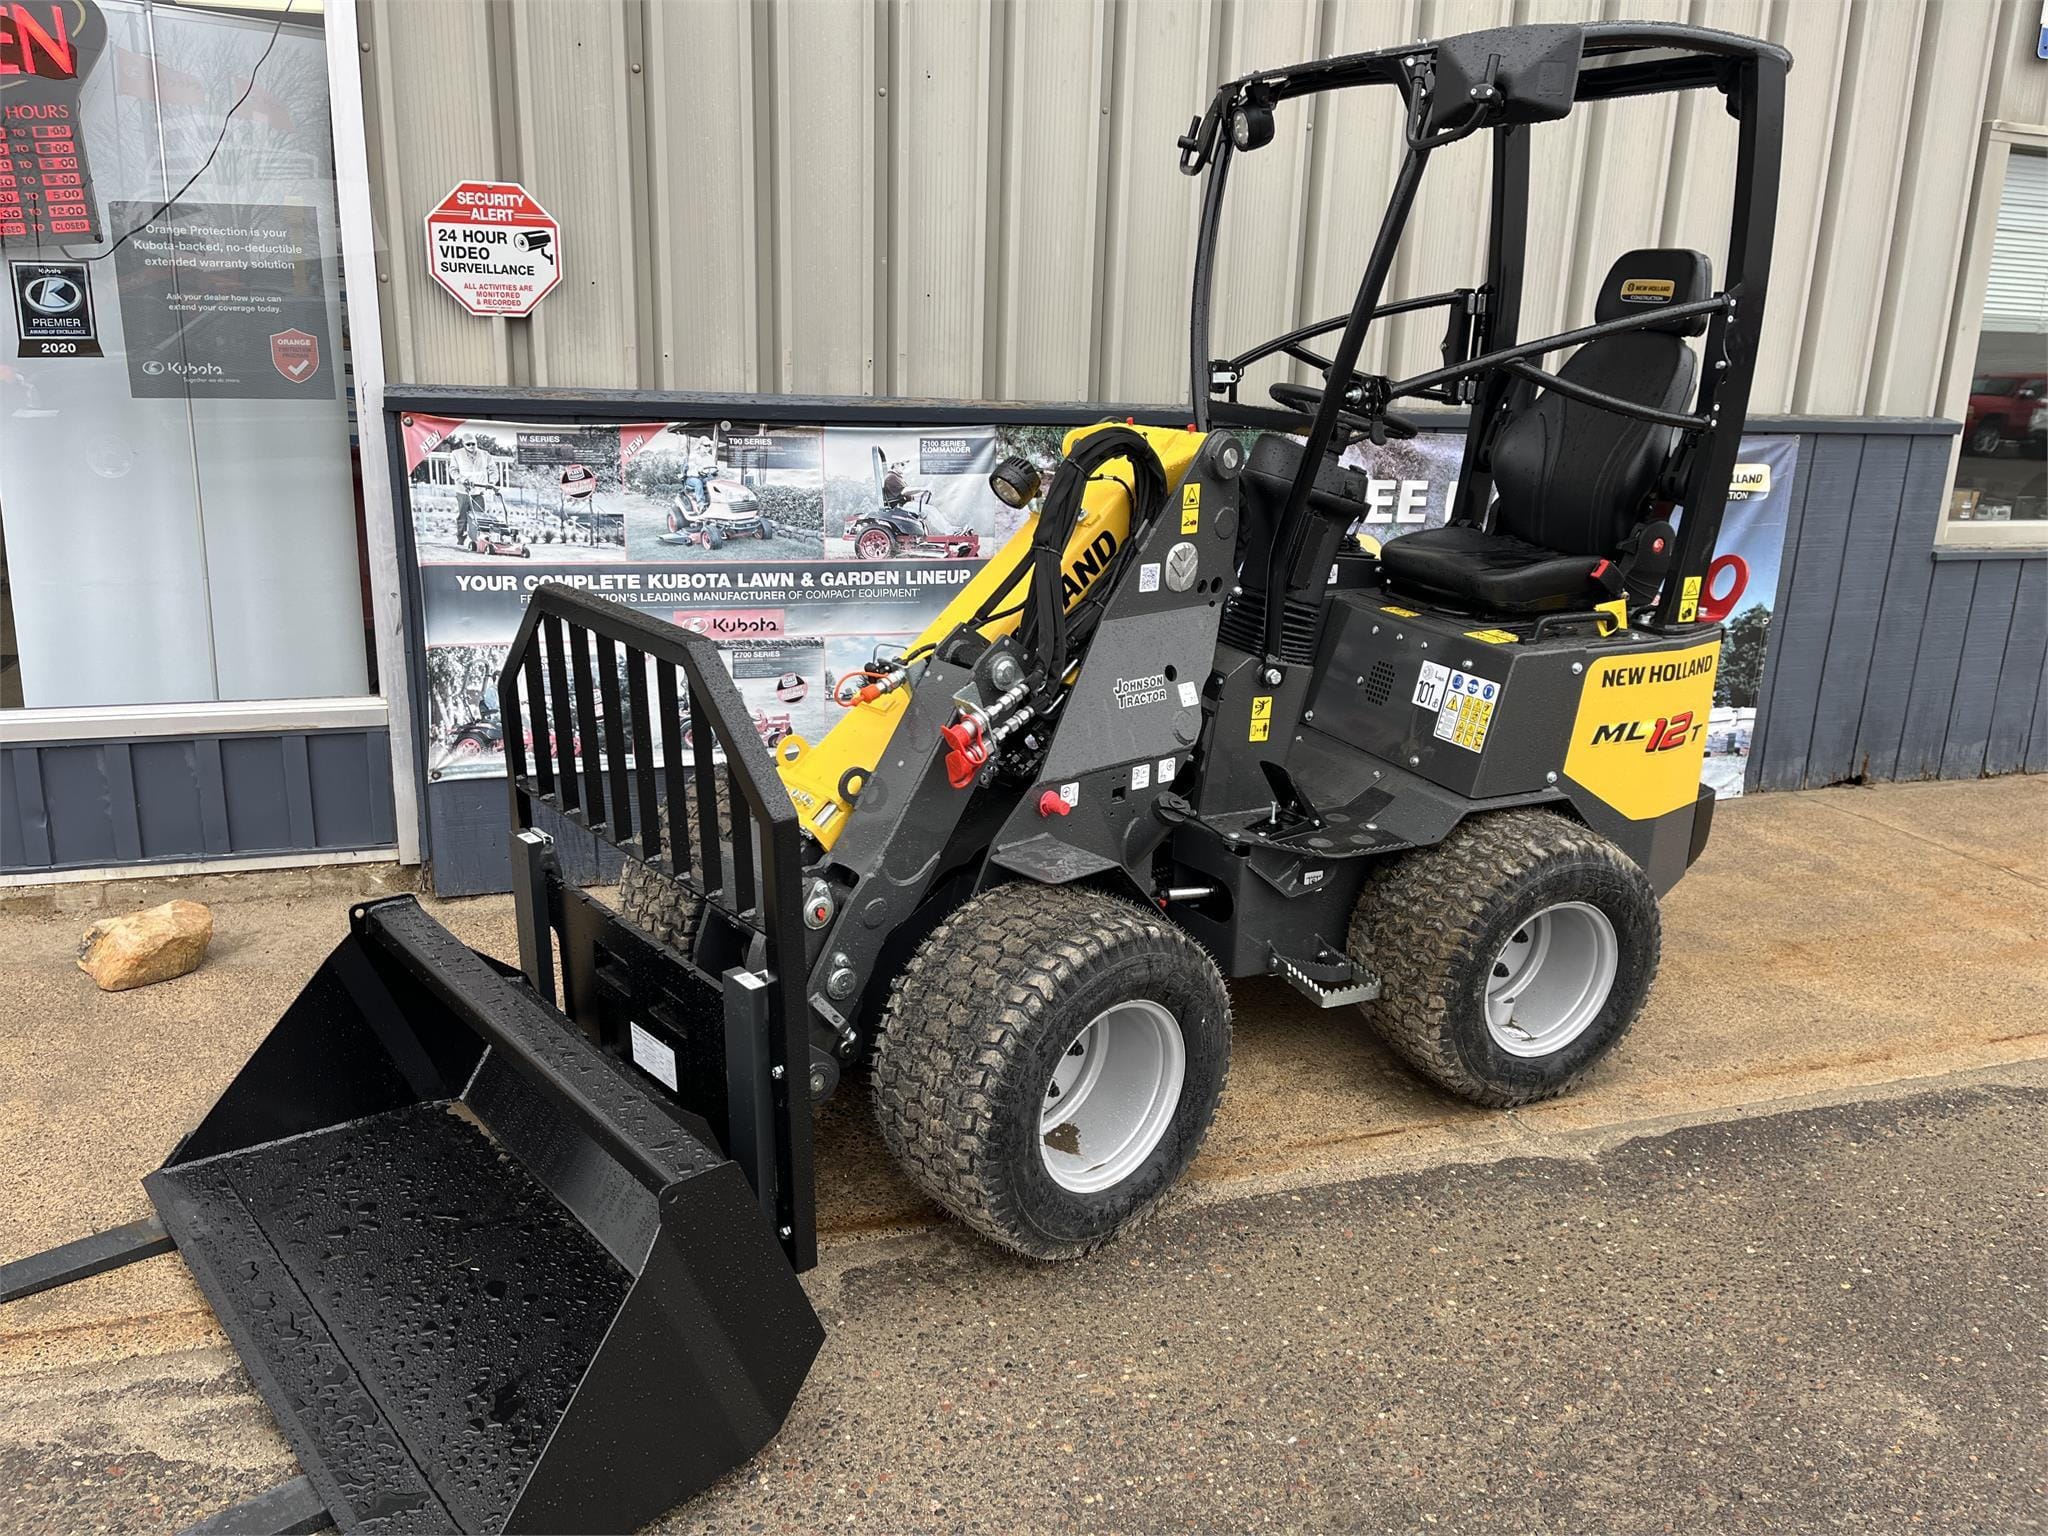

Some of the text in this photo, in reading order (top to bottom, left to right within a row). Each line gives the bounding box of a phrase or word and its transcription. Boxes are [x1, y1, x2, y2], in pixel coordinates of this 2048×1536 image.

[5, 104, 70, 119] HOURS
[11, 128, 26, 137] TO
[15, 144, 29, 153] TO
[18, 160, 32, 169] TO
[23, 176, 36, 185] TO
[26, 192, 39, 201] TO
[53, 190, 80, 199] 5:00
[456, 191, 525, 207] SECURITY
[51, 206, 85, 215] 12:00
[470, 207, 515, 222] ALERT
[55, 222, 86, 231] CLOSED
[145, 224, 287, 239] Orange Protection is your
[438, 228, 508, 245] 24 HOUR
[133, 240, 303, 255] Kubota-backed, no-deductible
[439, 244, 491, 260] VIDEO
[144, 257, 295, 271] extended warranty solution
[440, 261, 536, 277] SURVEILLANCE
[463, 282, 534, 292] ALL ACTIVITIES ARE
[183, 294, 202, 302] your
[204, 293, 229, 301] dealer
[231, 294, 249, 302] how
[250, 295, 265, 303] you
[475, 291, 521, 299] MONITORED
[168, 304, 283, 314] extend your coverage today.
[483, 299, 522, 307] RECORDED
[32, 318, 81, 327] PREMIER
[41, 342, 77, 354] 2020
[277, 338, 312, 346] ORANGE
[167, 361, 222, 375] Kubota
[419, 430, 441, 455] NEW
[519, 435, 561, 443] W SERIES
[743, 438, 773, 446] SERIES
[623, 435, 645, 458] NEW
[455, 574, 518, 592] YOUR
[647, 572, 731, 590] KUBOTA
[737, 572, 795, 589] LAWN
[801, 571, 815, 587] &
[820, 570, 900, 587] GARDEN
[905, 568, 972, 586] LINEUP
[640, 592, 692, 603] LEADING
[695, 590, 786, 602] MANUFACTURER
[788, 590, 805, 600] OF
[806, 589, 857, 600] COMPACT
[858, 588, 920, 598] EQUIPMENT
[713, 617, 777, 633] Kubota
[734, 650, 780, 659] Z700 SERIES
[1601, 655, 1713, 688] NEW HOLLAND
[1114, 675, 1164, 694] JOHNSON
[1117, 690, 1167, 708] TRACTOR
[1417, 680, 1436, 706] 101
